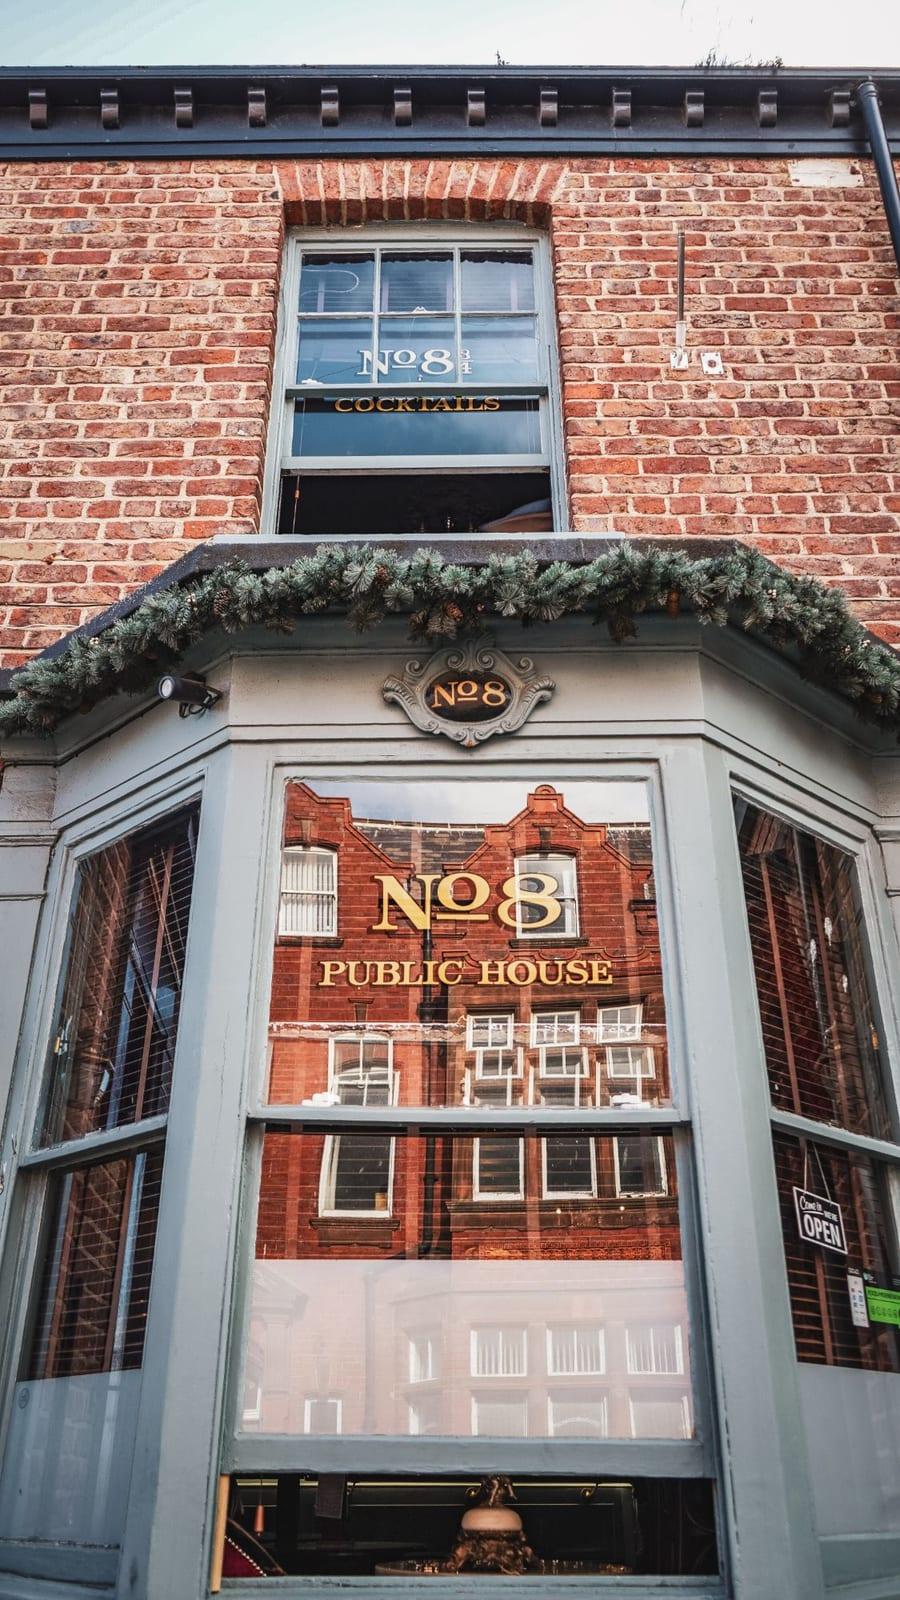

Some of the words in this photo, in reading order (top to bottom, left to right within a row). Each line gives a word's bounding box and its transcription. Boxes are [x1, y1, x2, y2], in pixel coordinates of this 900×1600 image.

[334, 396, 500, 412] COCKTAILS
[318, 961, 462, 986] PUBLIC
[477, 960, 613, 985] HOUSE
[803, 1213, 842, 1247] OPEN
